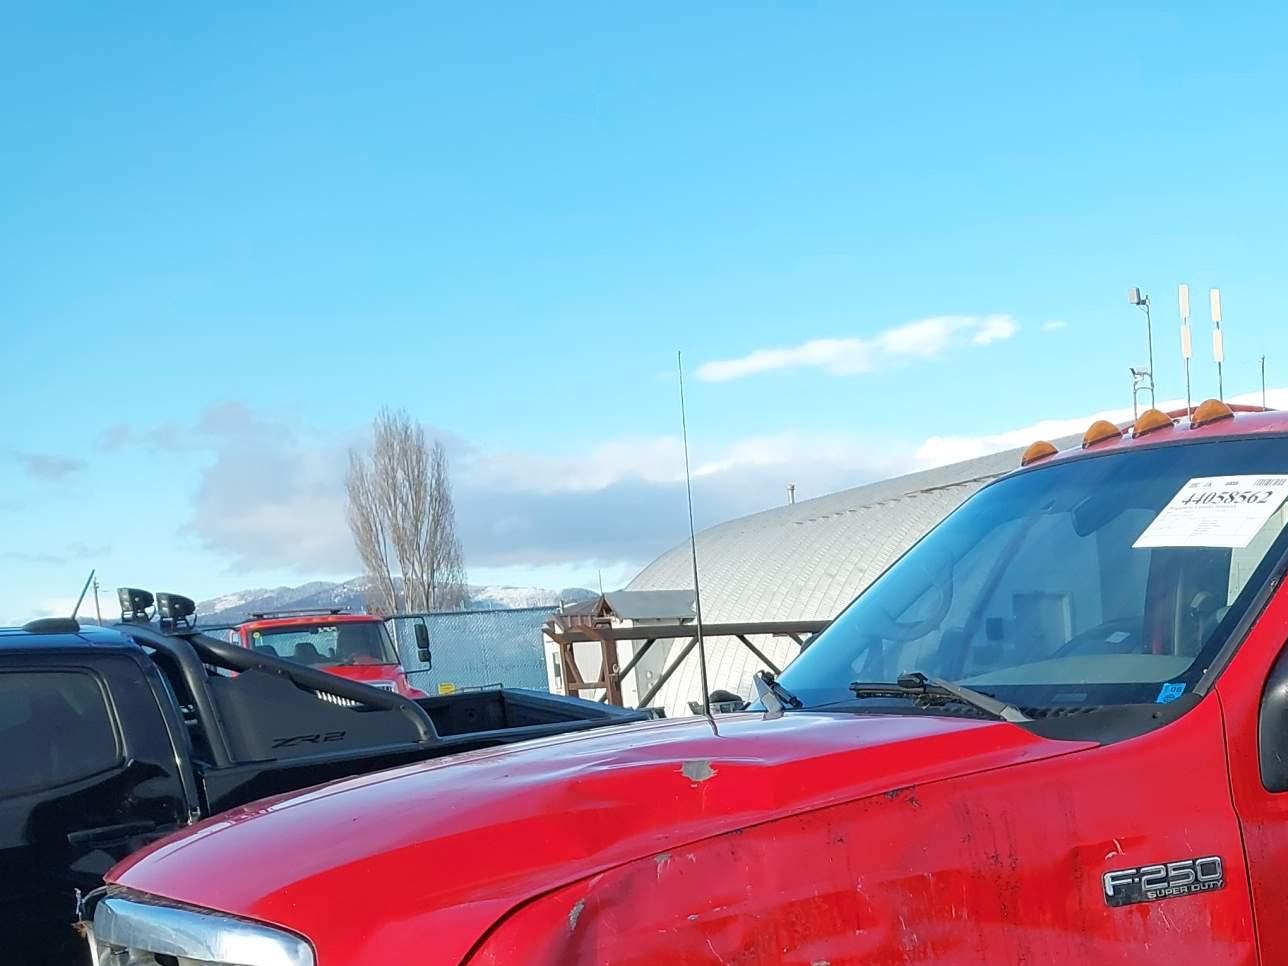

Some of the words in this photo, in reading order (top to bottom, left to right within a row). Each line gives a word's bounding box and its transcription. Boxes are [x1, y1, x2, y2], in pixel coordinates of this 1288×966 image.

[1181, 489, 1273, 506] 44058562
[271, 730, 347, 749] ZR2
[1147, 887, 1188, 899] SUPER
[1190, 880, 1224, 892] DUTY
